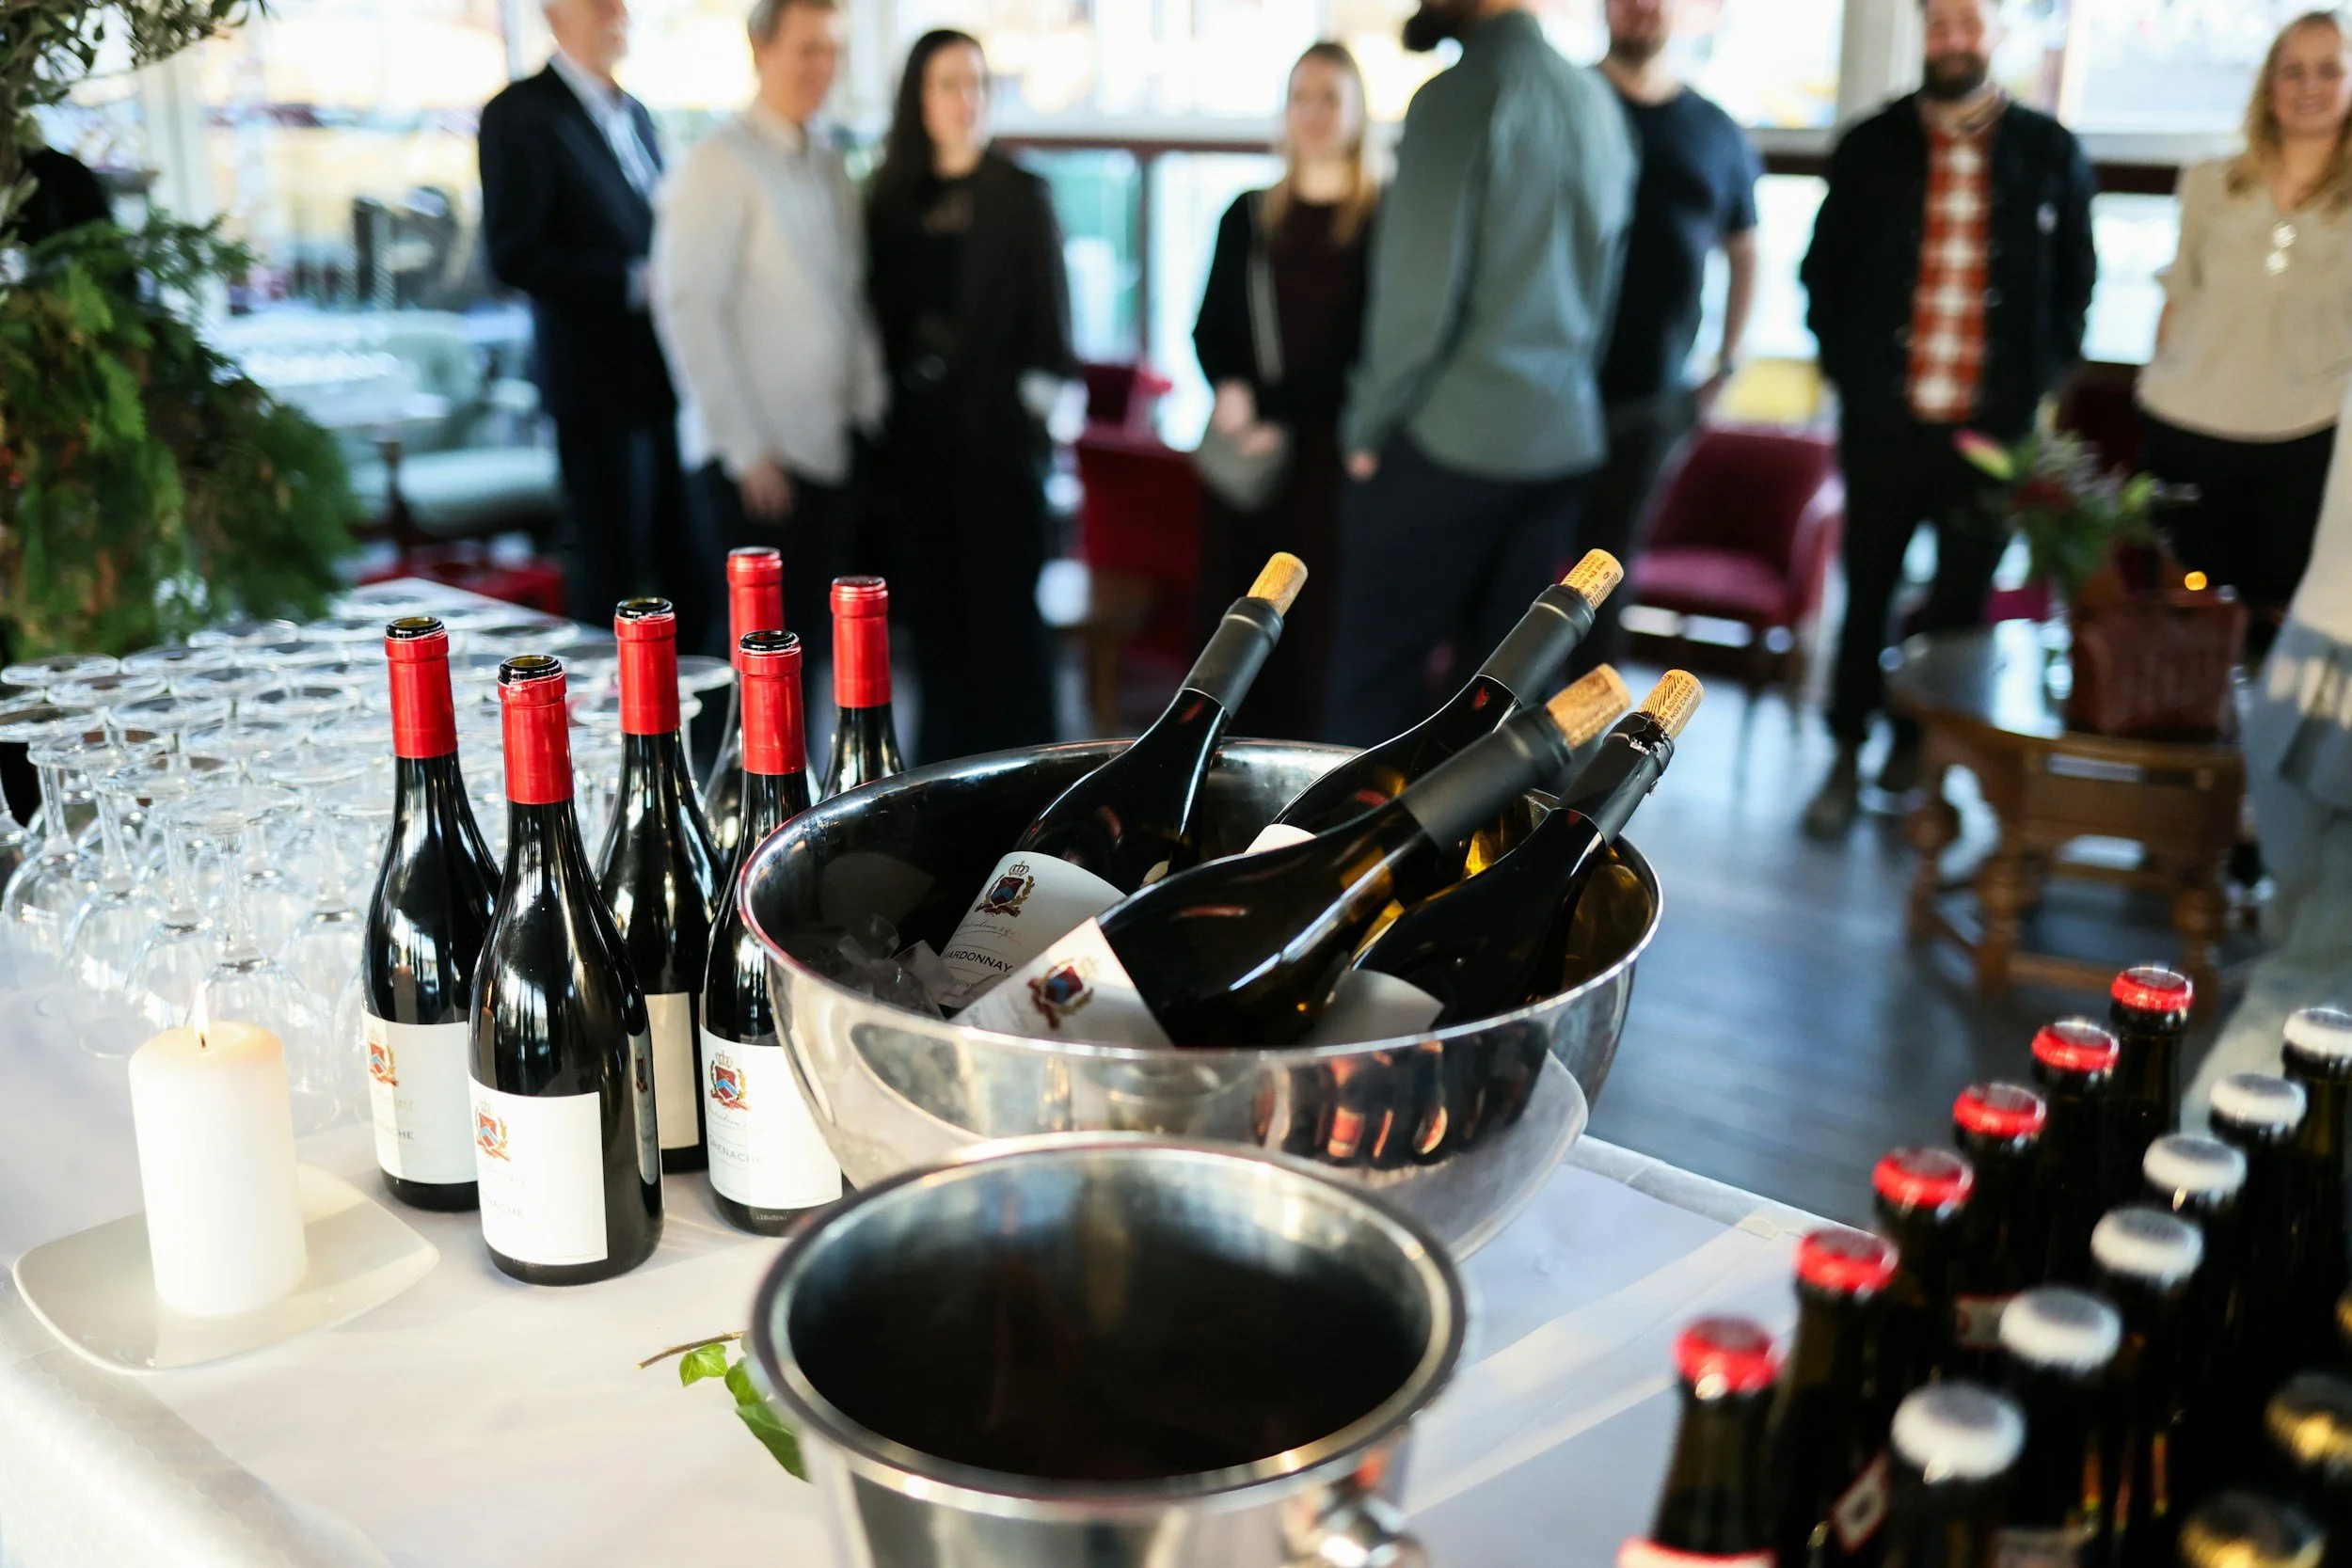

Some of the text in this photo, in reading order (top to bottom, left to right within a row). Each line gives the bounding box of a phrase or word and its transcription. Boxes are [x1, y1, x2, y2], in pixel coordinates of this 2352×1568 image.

[1659, 680, 1691, 721] EN BOUTEILLE
[1671, 705, 1681, 719] NOS
[1680, 686, 1695, 705] CAVES
[942, 950, 1013, 973] HARDONNAY
